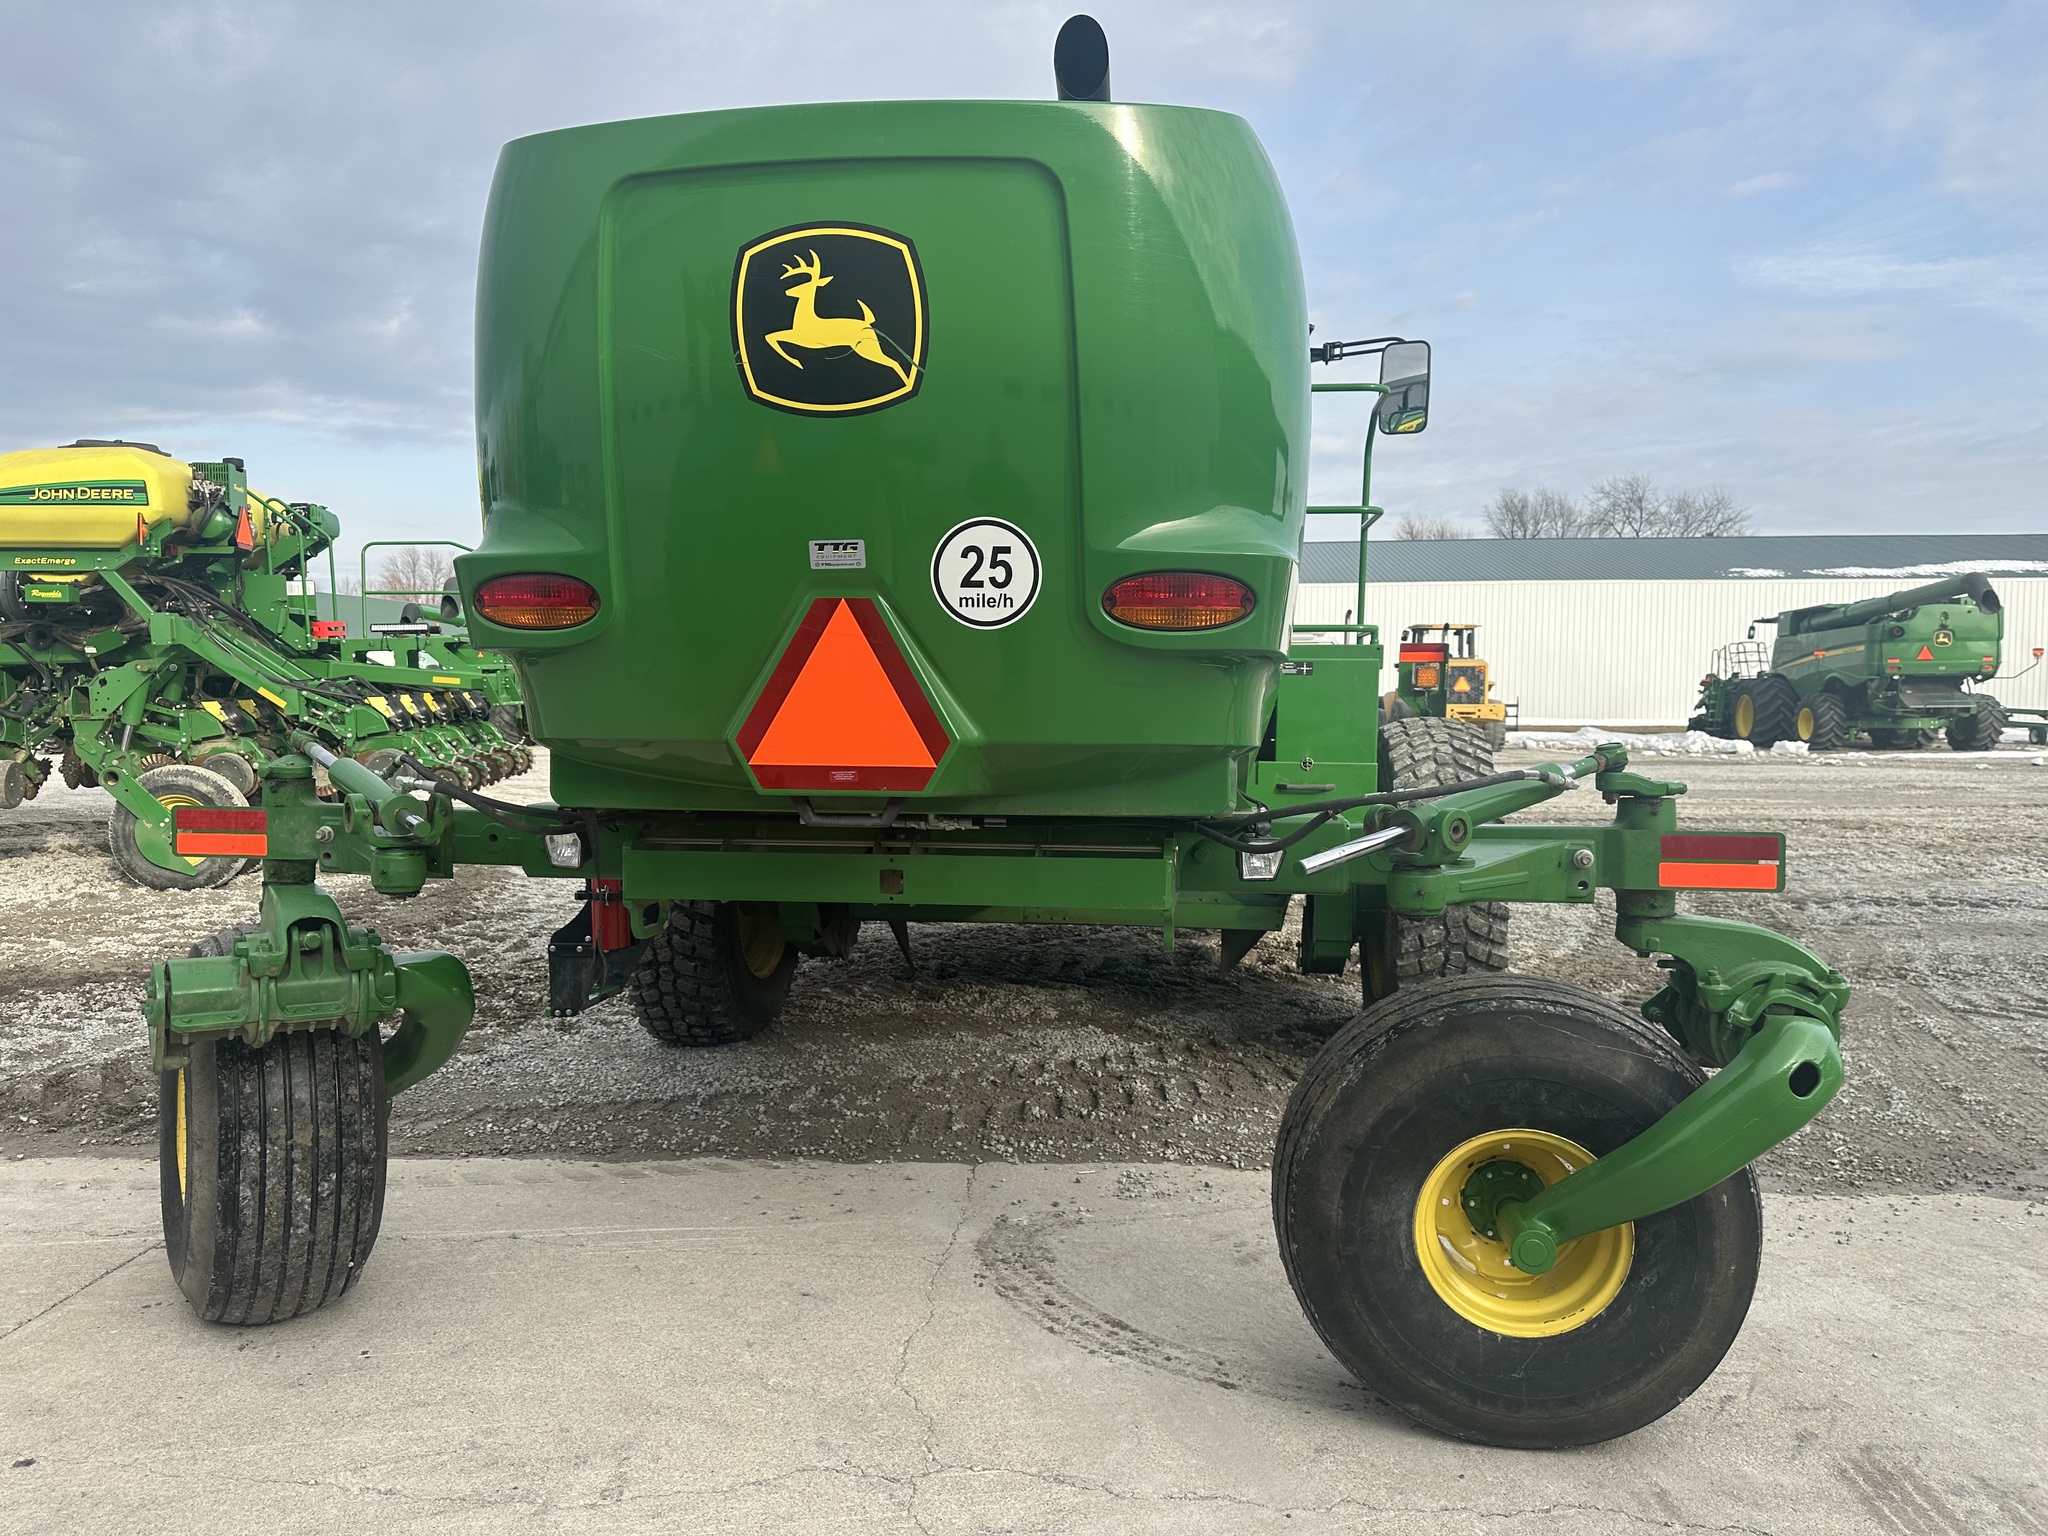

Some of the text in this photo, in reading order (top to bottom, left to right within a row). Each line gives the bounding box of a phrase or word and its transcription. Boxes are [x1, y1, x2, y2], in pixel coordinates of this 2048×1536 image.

[29, 487, 134, 501] JOHN DEERE
[814, 542, 859, 554] TTG
[14, 557, 77, 566] ExactEmerge
[959, 545, 1013, 589] 25
[31, 589, 62, 598] Reynolds
[958, 593, 1014, 609] mile/h
